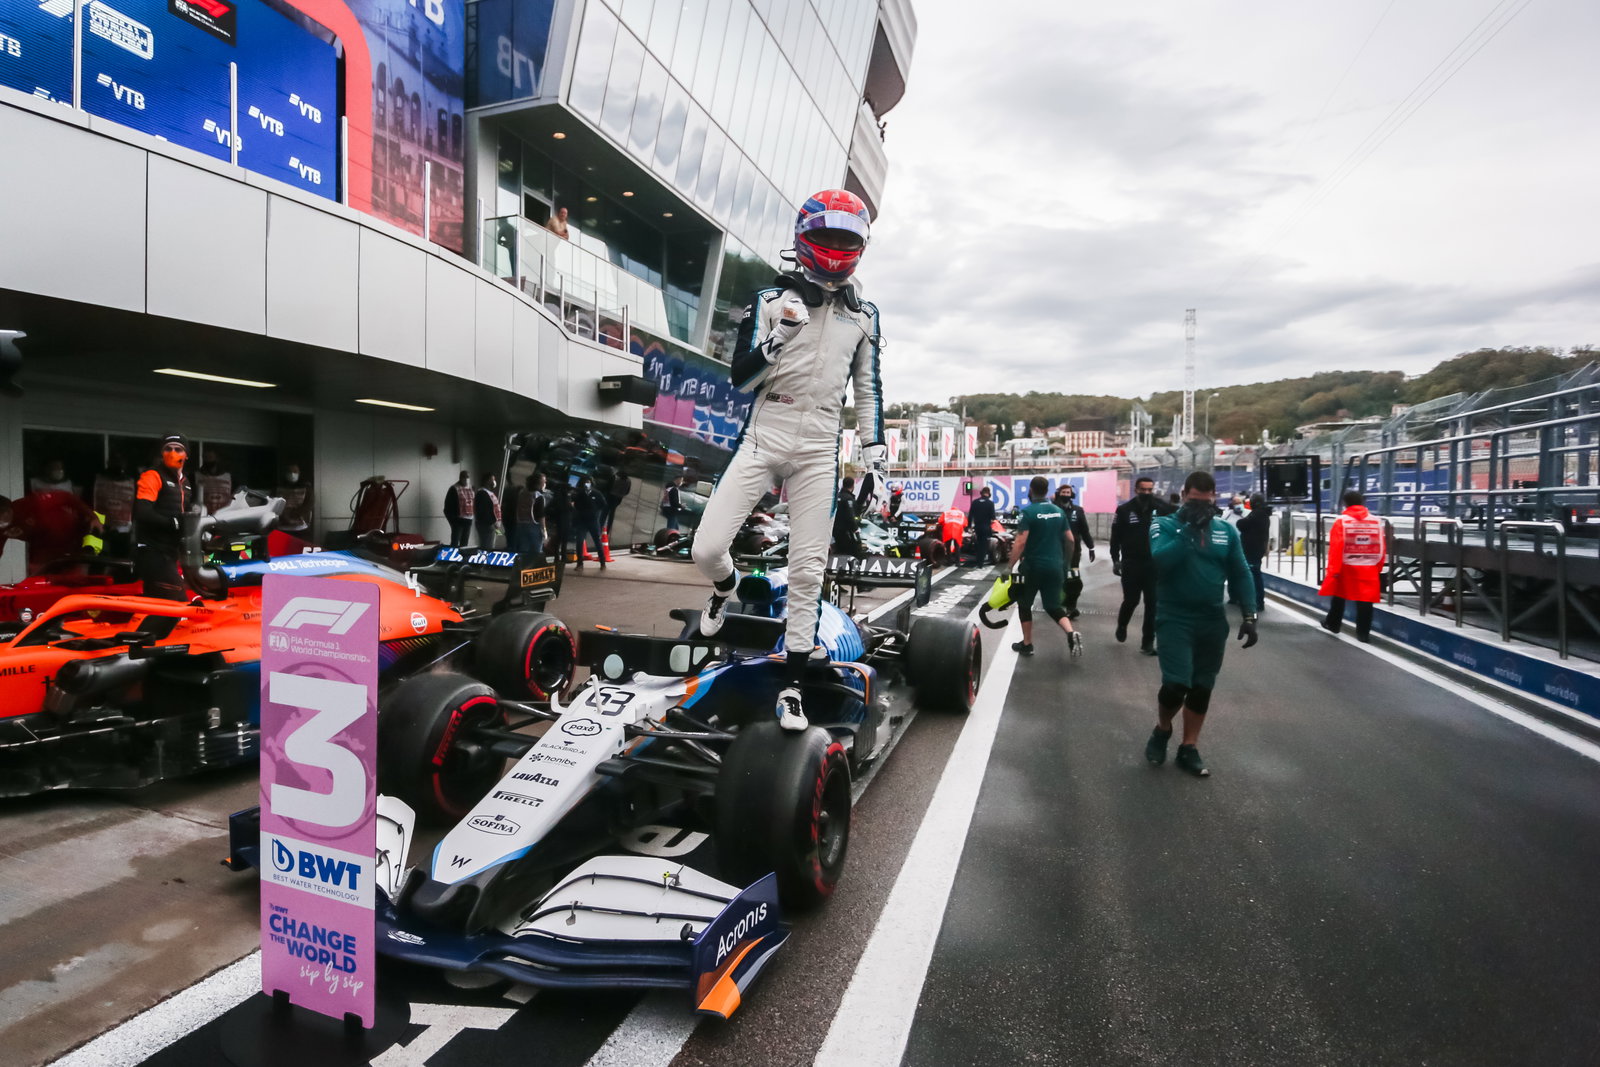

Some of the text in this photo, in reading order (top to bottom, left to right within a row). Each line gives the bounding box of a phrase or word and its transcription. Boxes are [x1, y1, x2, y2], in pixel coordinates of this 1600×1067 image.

[112, 81, 146, 111] VTB
[300, 100, 322, 124] VTB
[260, 112, 284, 137] VTB
[299, 163, 322, 185] VTB
[885, 480, 940, 491] CANGE
[268, 560, 297, 571] DELL
[404, 570, 421, 598] 4
[412, 619, 427, 628] Gulf
[269, 634, 288, 649] FIA
[290, 636, 304, 646] FIA
[304, 638, 335, 650] Formula
[291, 645, 367, 663] World Championship
[1493, 666, 1522, 685] workday
[585, 686, 635, 716] 63
[1544, 683, 1580, 706] workday
[568, 724, 596, 733] pax8
[269, 671, 368, 828] 3
[544, 755, 577, 767] honibe
[511, 772, 560, 788] LAVAZZA
[492, 790, 544, 808] PIRELLI
[472, 817, 514, 834] SOFINA
[298, 850, 361, 891] BWT
[272, 873, 361, 903] BEST WATER TECHNOLOGY
[269, 913, 357, 956] CHANGE
[715, 902, 768, 967] Acronis
[269, 932, 357, 974] THE WORLD
[300, 960, 365, 998] sip by sip
